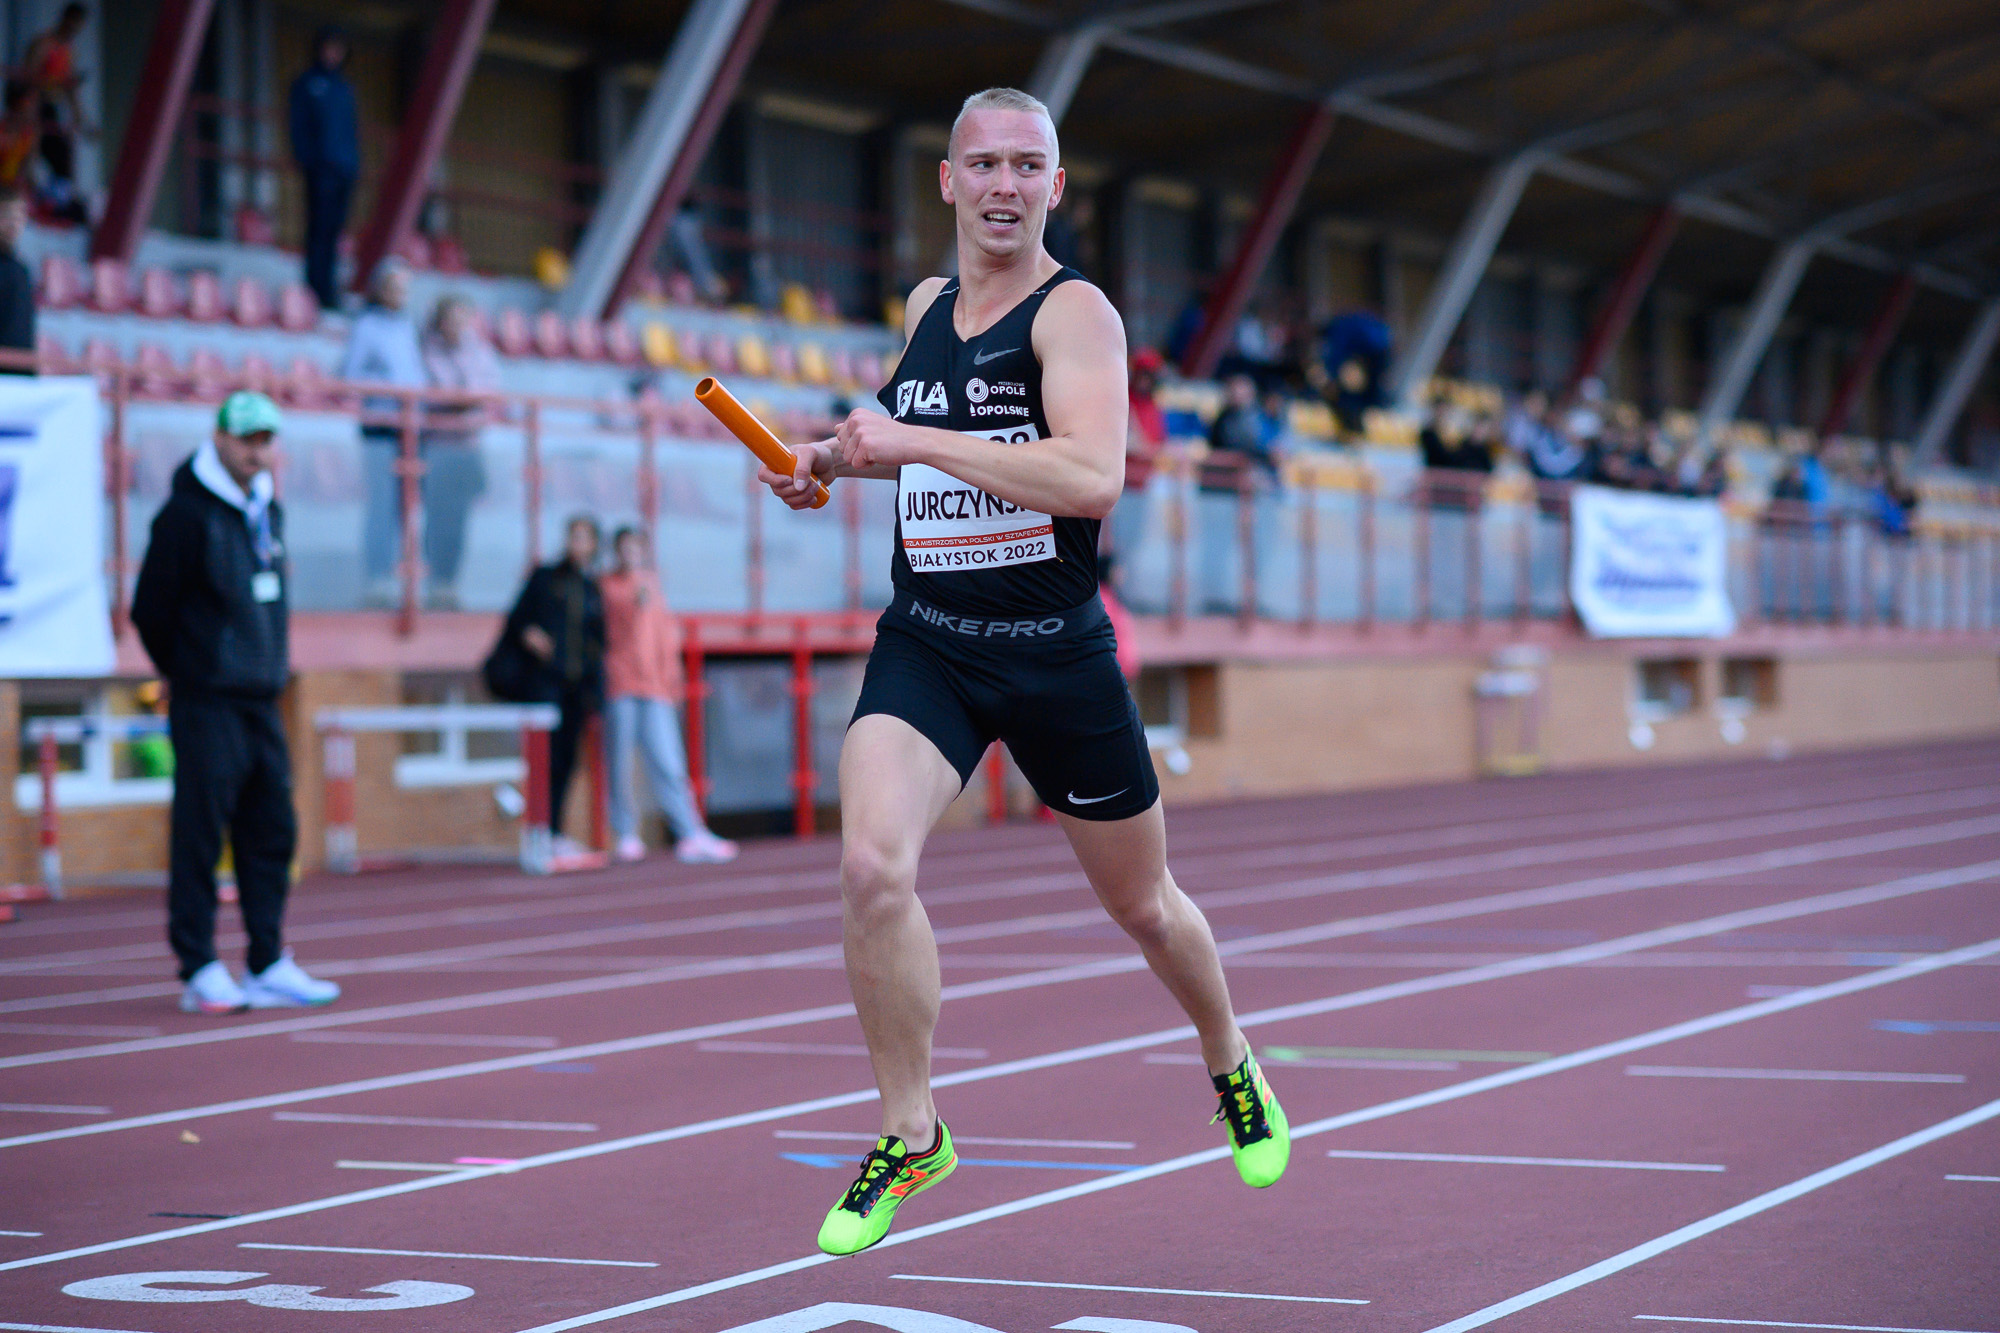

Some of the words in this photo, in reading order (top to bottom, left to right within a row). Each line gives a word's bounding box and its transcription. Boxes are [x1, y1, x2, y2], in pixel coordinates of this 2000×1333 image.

[990, 385, 1026, 396] OPOLE
[905, 490, 1026, 522] JURCZYN
[920, 538, 968, 547] MISTRZOSTWA
[969, 535, 995, 544] POLSKI
[996, 533, 1004, 541] W
[1004, 527, 1050, 540] SZTAFETACH
[910, 548, 999, 568] BIAŁYSTOK
[1003, 541, 1047, 561] 2022
[909, 600, 984, 636] NIKE
[984, 617, 1065, 638] PRO
